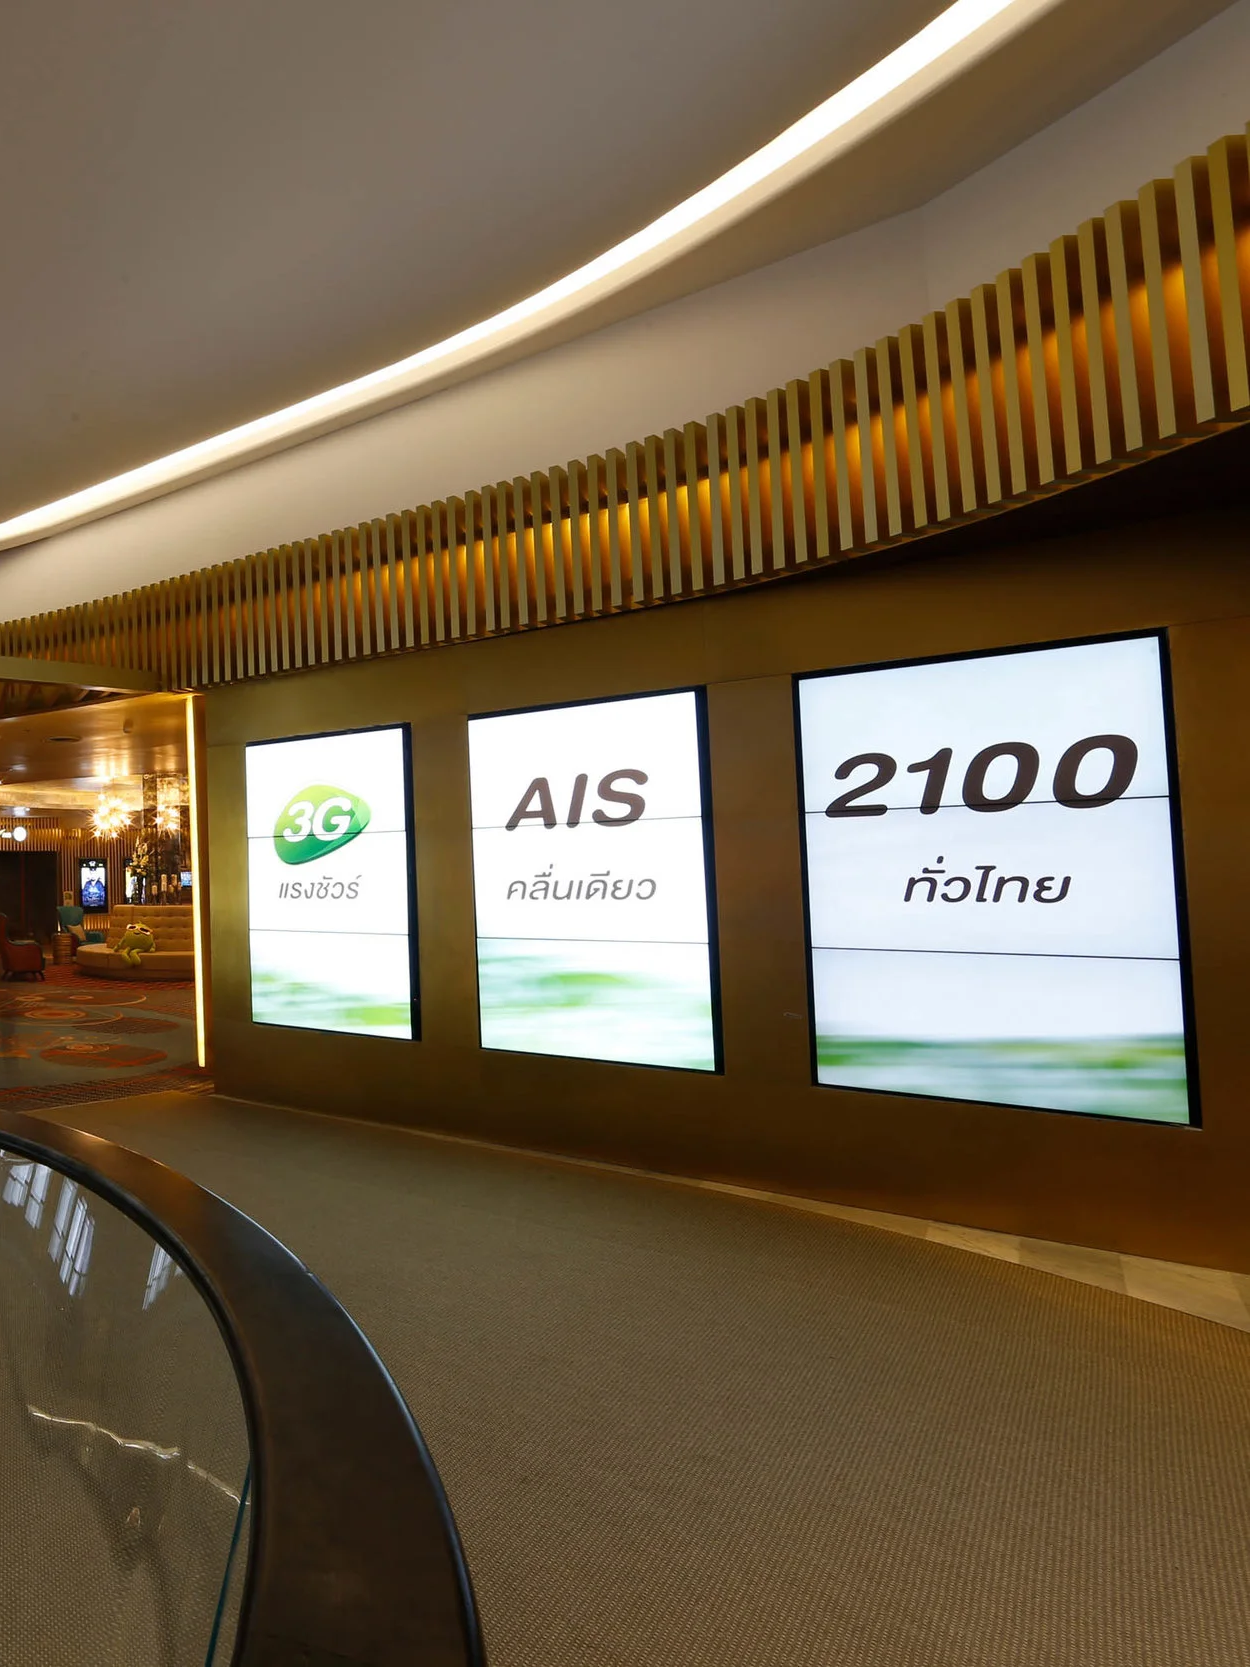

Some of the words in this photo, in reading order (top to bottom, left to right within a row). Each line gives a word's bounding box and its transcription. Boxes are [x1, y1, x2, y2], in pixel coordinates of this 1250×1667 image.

[504, 768, 649, 832] AIS
[825, 733, 1139, 818] 2100
[282, 794, 355, 843] 3G
[278, 874, 362, 900] แรงชัวร์
[506, 863, 657, 901] คลื่นเดียว
[903, 855, 1072, 904] ทั่วไทย
